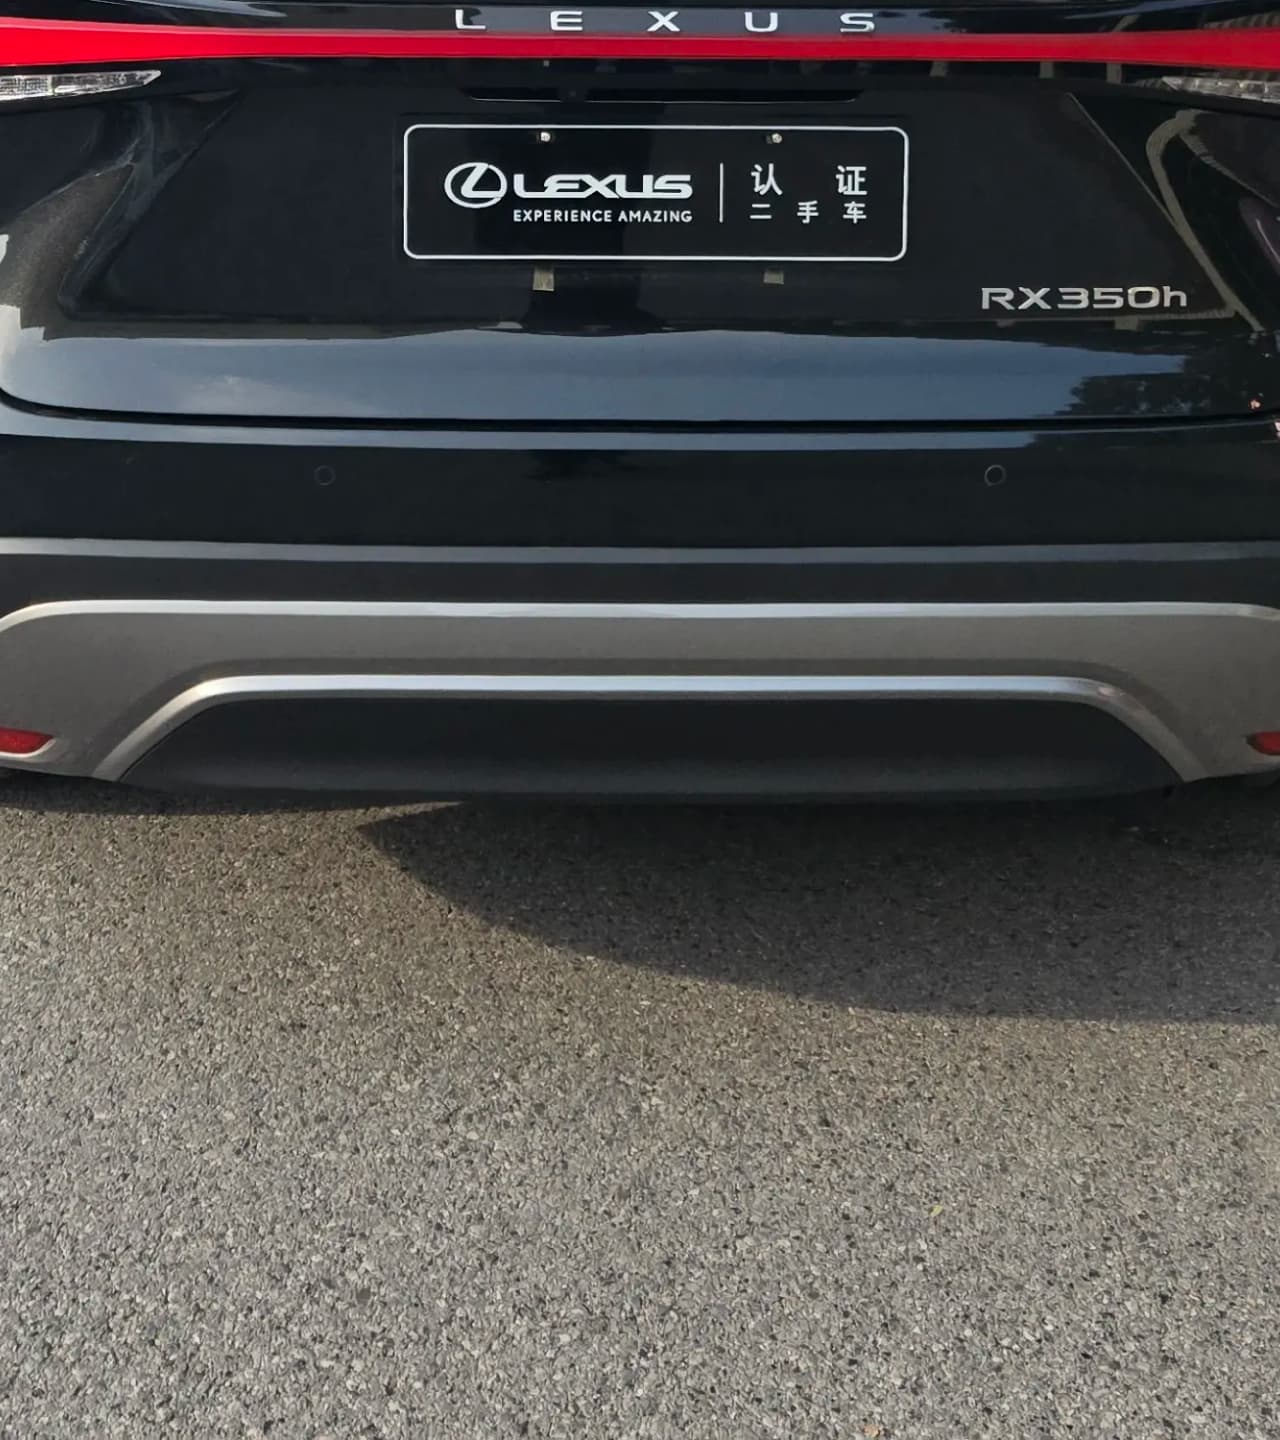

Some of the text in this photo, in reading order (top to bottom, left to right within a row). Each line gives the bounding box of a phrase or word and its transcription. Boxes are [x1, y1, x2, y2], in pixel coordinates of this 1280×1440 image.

[455, 8, 876, 33] LEXUS
[513, 173, 693, 200] LEXUS
[750, 163, 868, 197] 认证
[513, 209, 693, 224] EXPERIENCE AMAZING
[749, 200, 868, 225] 二手车
